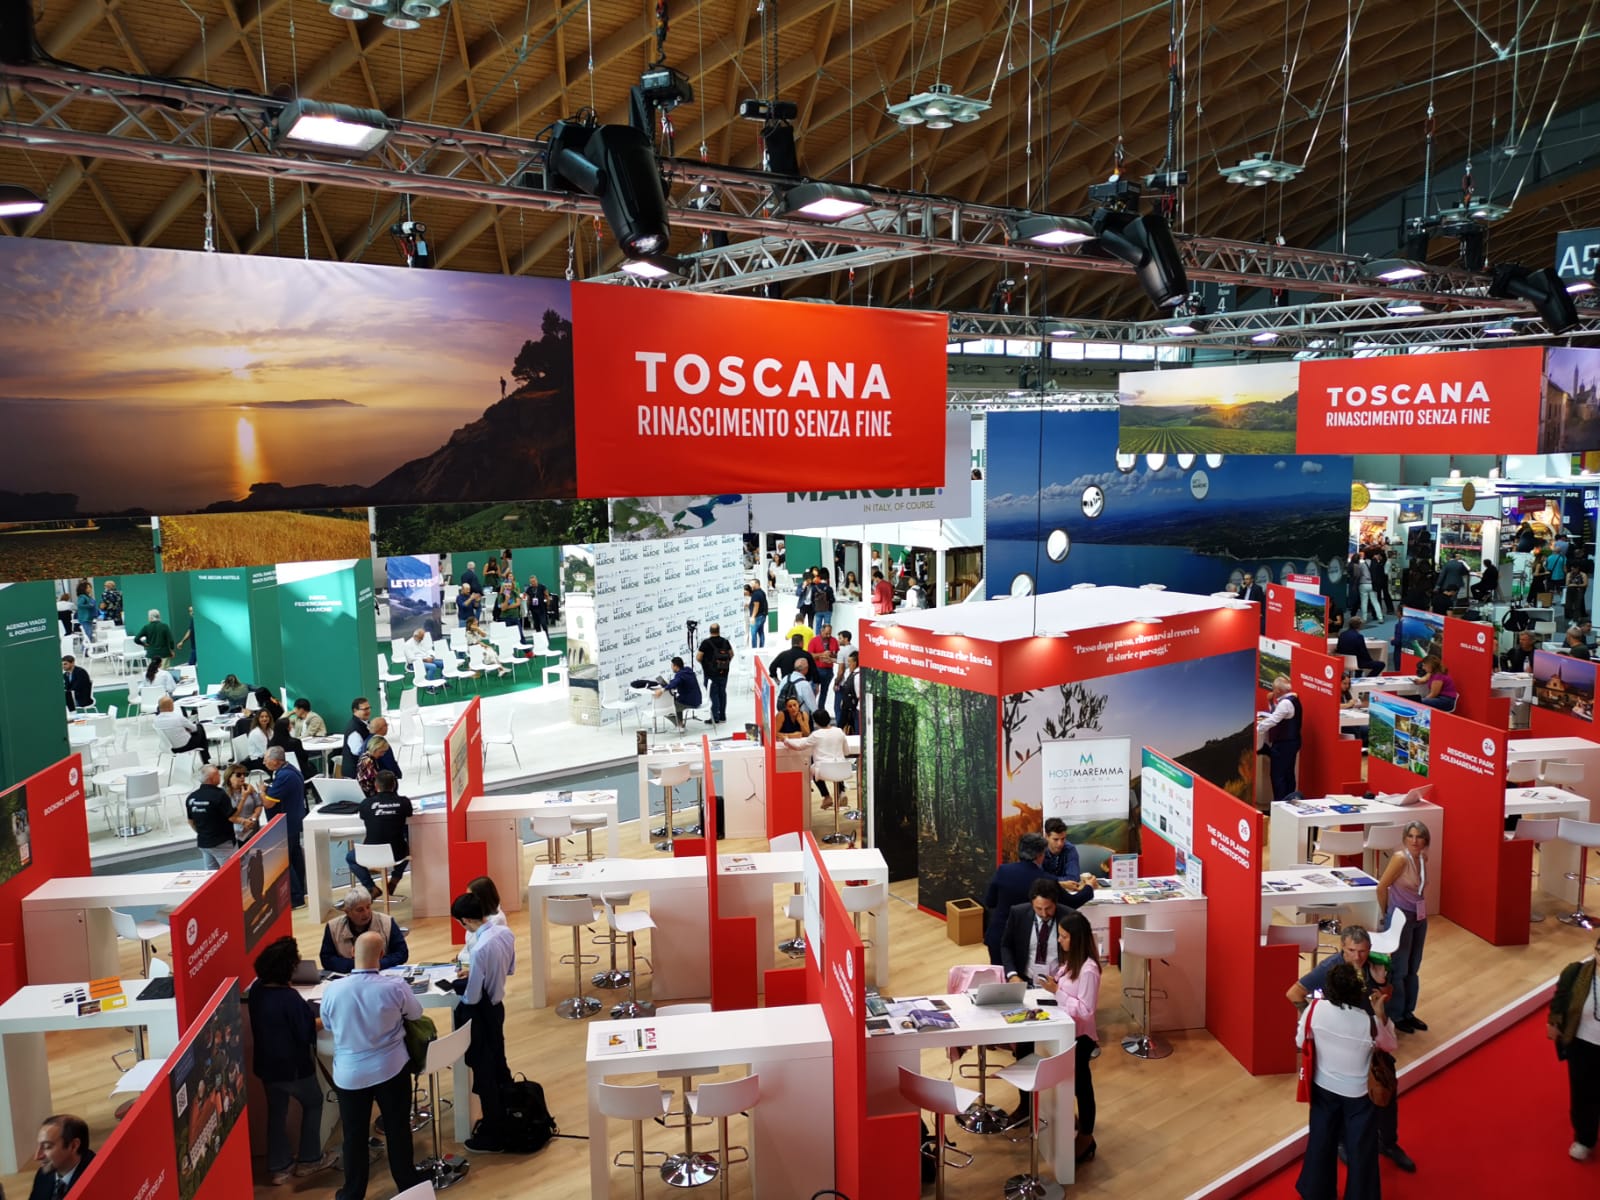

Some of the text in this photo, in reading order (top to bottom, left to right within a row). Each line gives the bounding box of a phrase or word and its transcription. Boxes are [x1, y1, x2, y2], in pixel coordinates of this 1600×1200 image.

[1558, 244, 1600, 277] A5
[635, 351, 891, 399] TOSCANA
[1326, 381, 1490, 407] TOSCANA
[637, 405, 892, 437] RINASCIMENTO SENZA FINE
[1326, 408, 1491, 427] RINASCIMENTO SENZA FINE
[864, 504, 871, 512] IN
[872, 503, 892, 512] ITALY,
[894, 502, 904, 511] OF
[910, 644, 924, 653] una
[956, 651, 968, 662] che
[970, 654, 992, 666] lascia
[911, 658, 924, 667] non
[1106, 653, 1114, 663] di
[1048, 768, 1124, 778] HOSTMAREMMA
[1206, 824, 1216, 836] THE
[1230, 839, 1250, 858] PLANET
[188, 939, 208, 966] CHIANTI
[189, 931, 228, 979] TOUR OPERATOR
